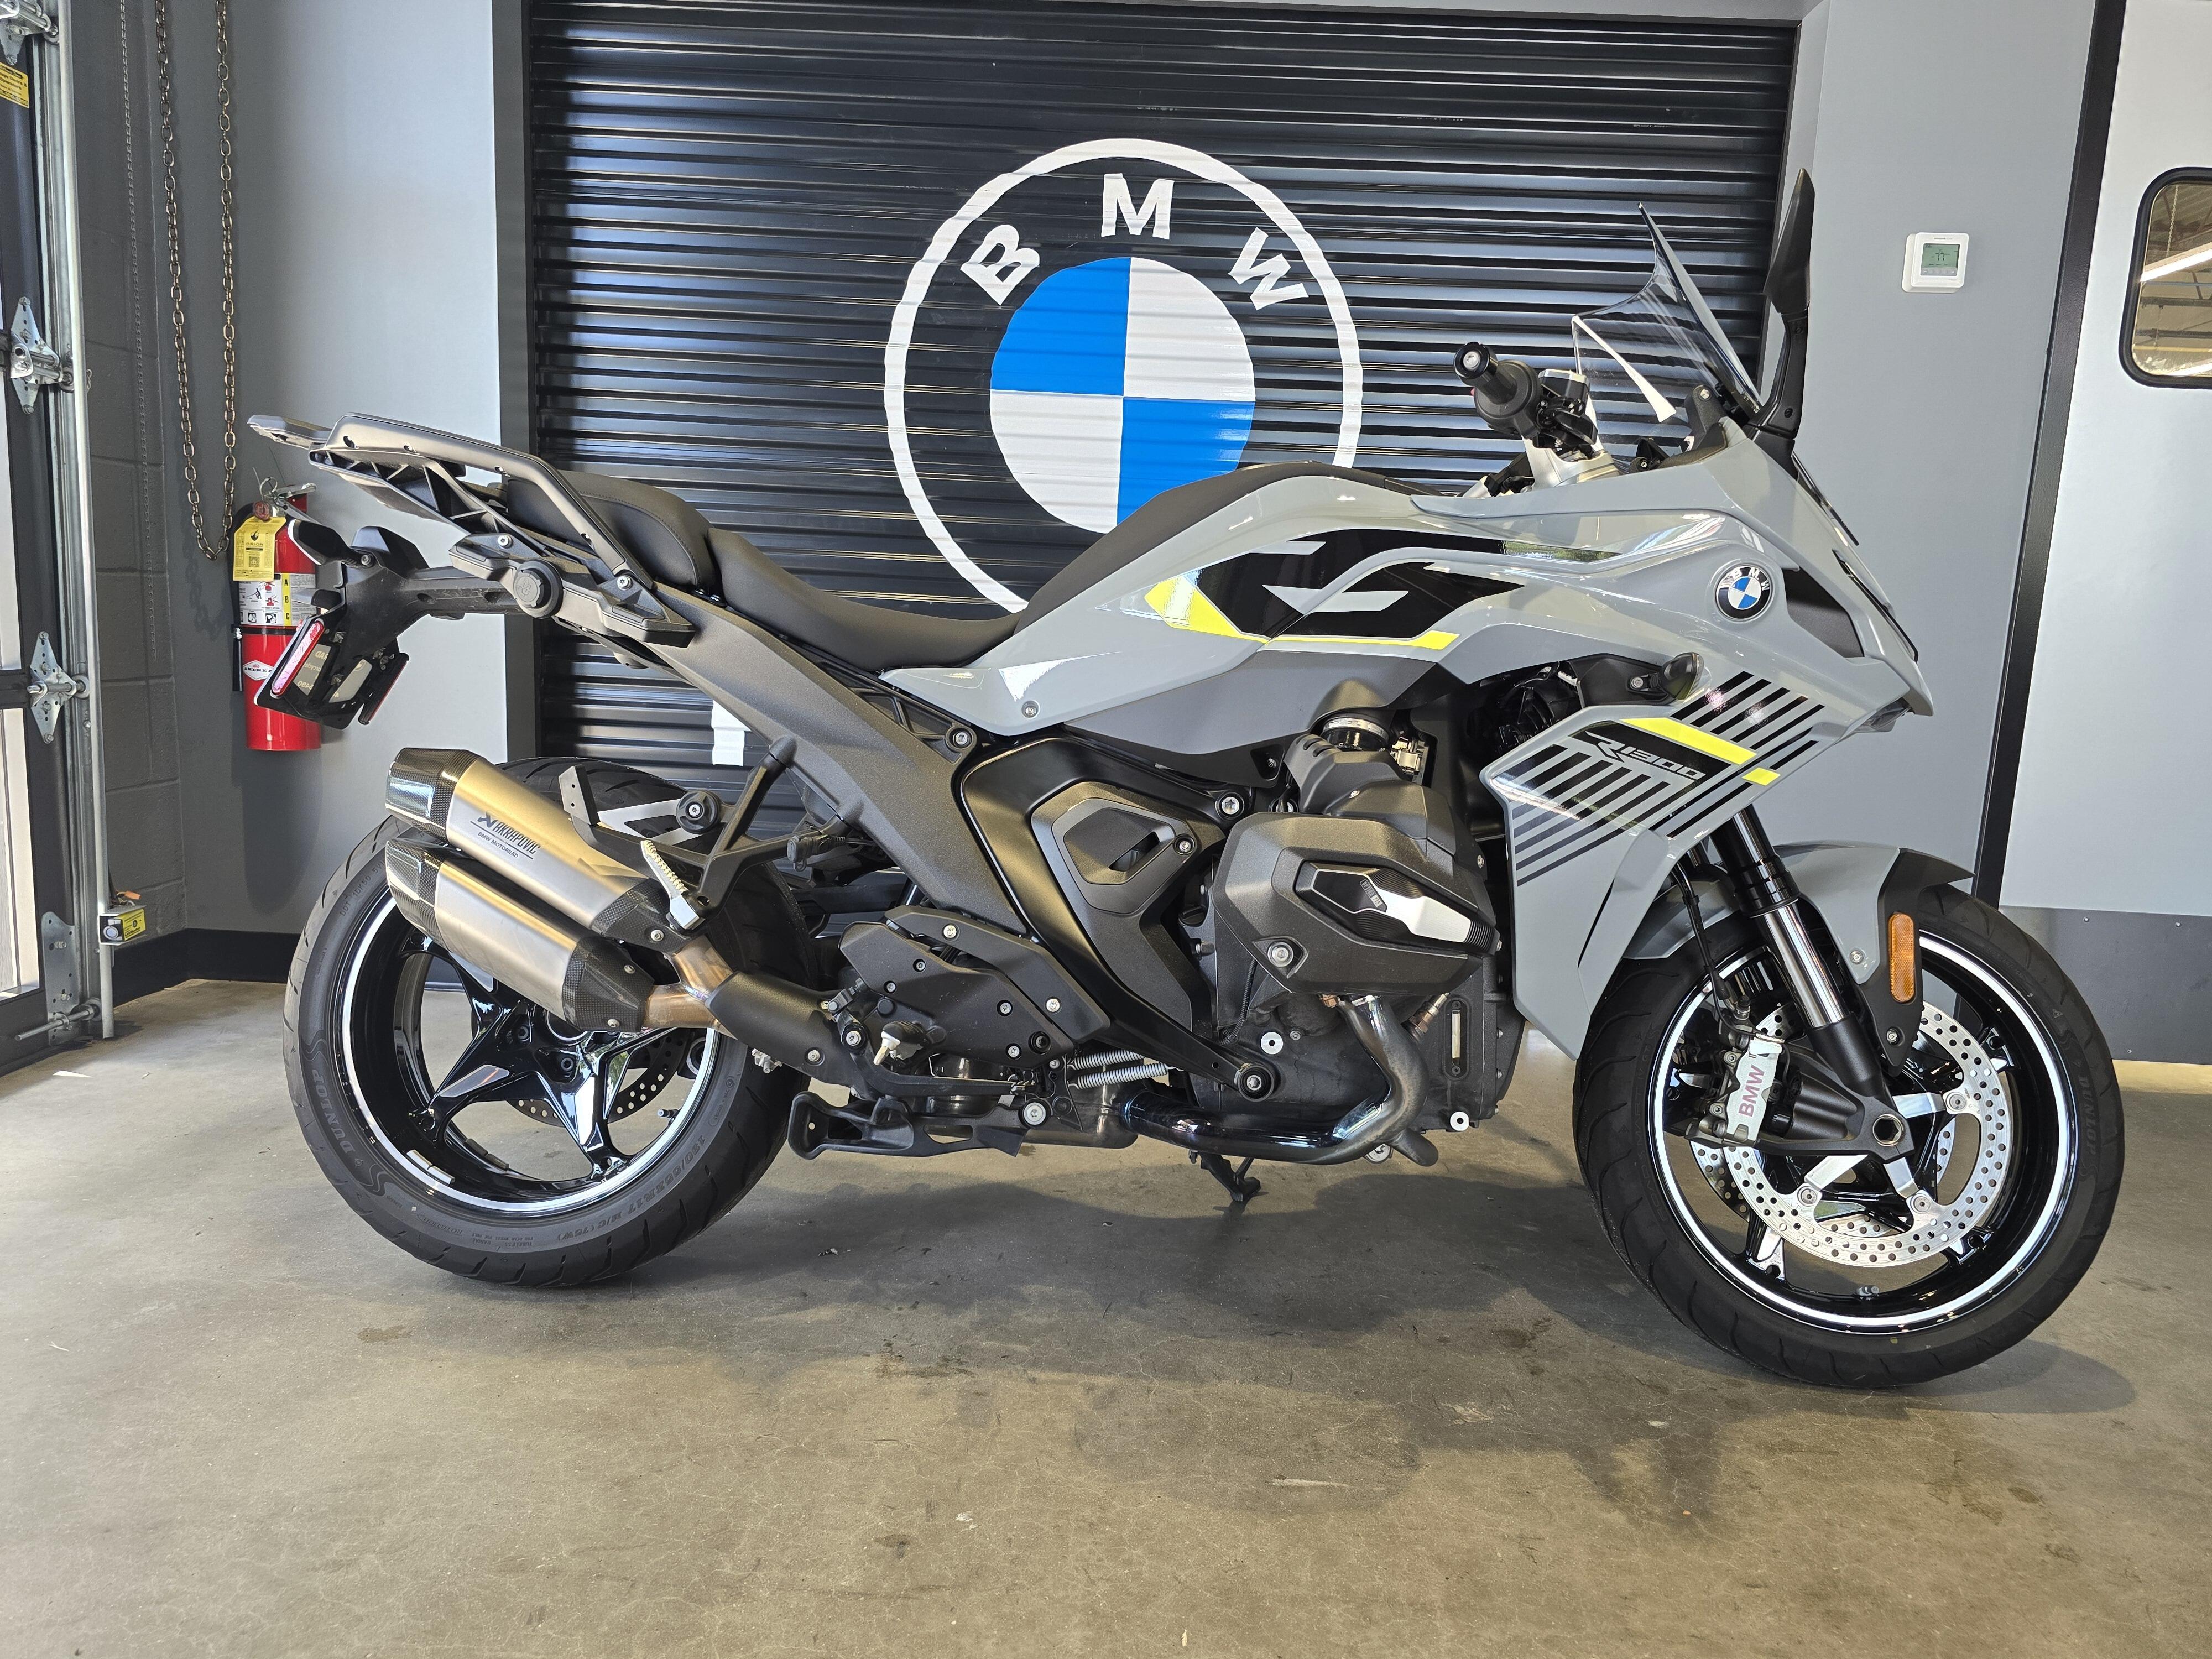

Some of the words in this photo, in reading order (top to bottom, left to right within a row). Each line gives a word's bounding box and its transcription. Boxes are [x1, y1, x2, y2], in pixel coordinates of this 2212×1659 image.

[960, 173, 1309, 311] BMW
[1935, 253, 1945, 262] 77
[1732, 567, 1770, 591] BMW
[477, 831, 492, 842] BMW
[491, 839, 519, 858] MOTORRAD
[312, 1070, 356, 1154] DUNLOP
[1738, 1064, 1765, 1117] BMW
[2078, 1074, 2096, 1156] DUNLOP
